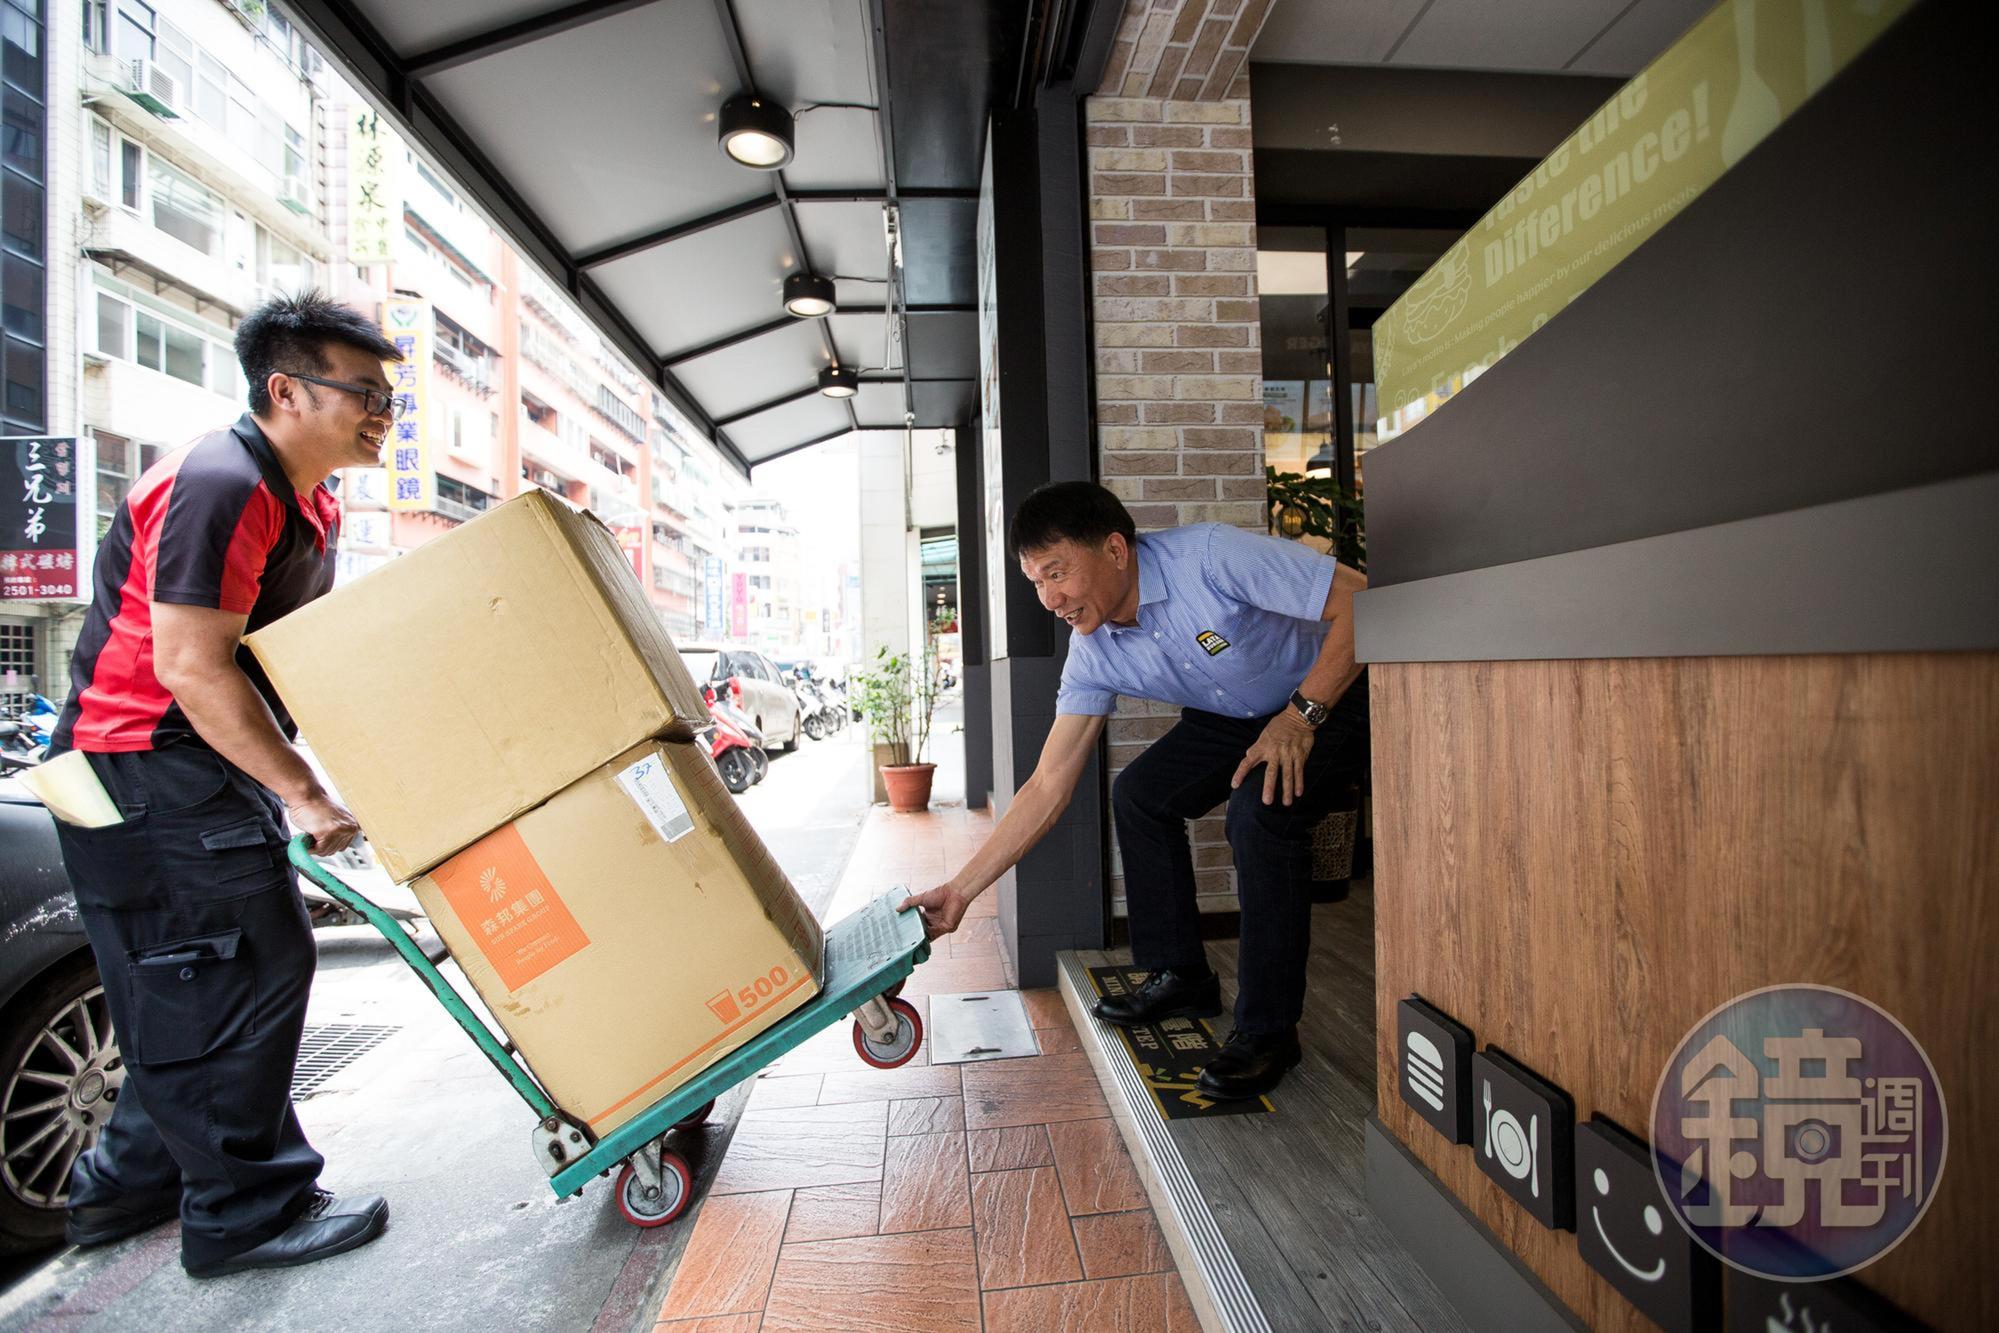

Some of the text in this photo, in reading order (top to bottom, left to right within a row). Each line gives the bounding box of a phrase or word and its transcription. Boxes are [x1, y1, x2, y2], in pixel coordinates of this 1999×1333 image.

[1484, 80, 1711, 288] Difference!
[1454, 322, 1484, 347] Making
[1484, 302, 1515, 331] people
[1516, 275, 1556, 311] happier
[1557, 261, 1570, 278] by
[1572, 247, 1593, 271] our
[1594, 212, 1652, 258] delicious
[23, 442, 53, 544] 三兄弟
[480, 889, 545, 936] 森邦集團
[738, 966, 789, 1008] 500
[1131, 1025, 1159, 1050] TEP
